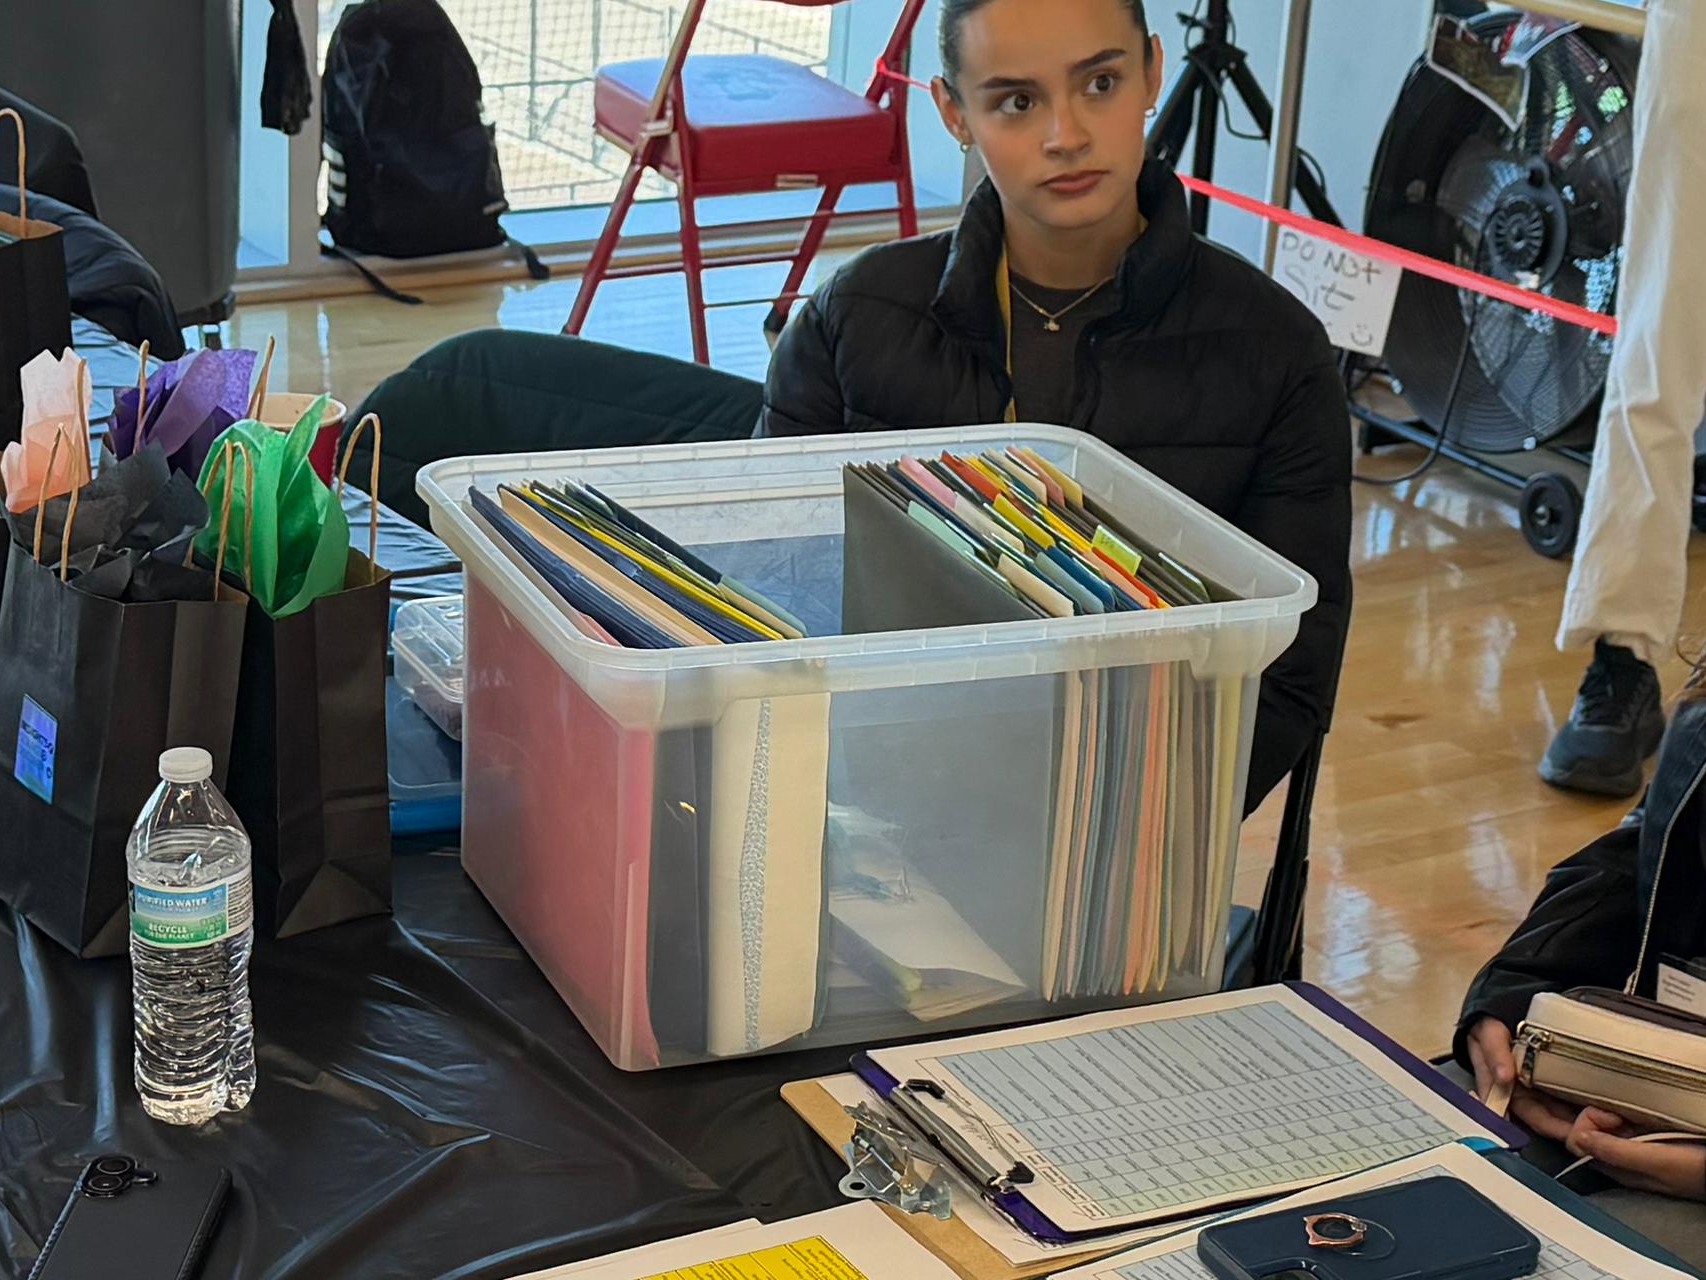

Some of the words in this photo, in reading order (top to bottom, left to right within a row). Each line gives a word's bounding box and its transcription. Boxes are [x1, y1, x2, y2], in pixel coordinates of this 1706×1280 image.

[1283, 232, 1314, 261] DO
[176, 897, 207, 907] WATER
[149, 923, 187, 934] RECYCLE
